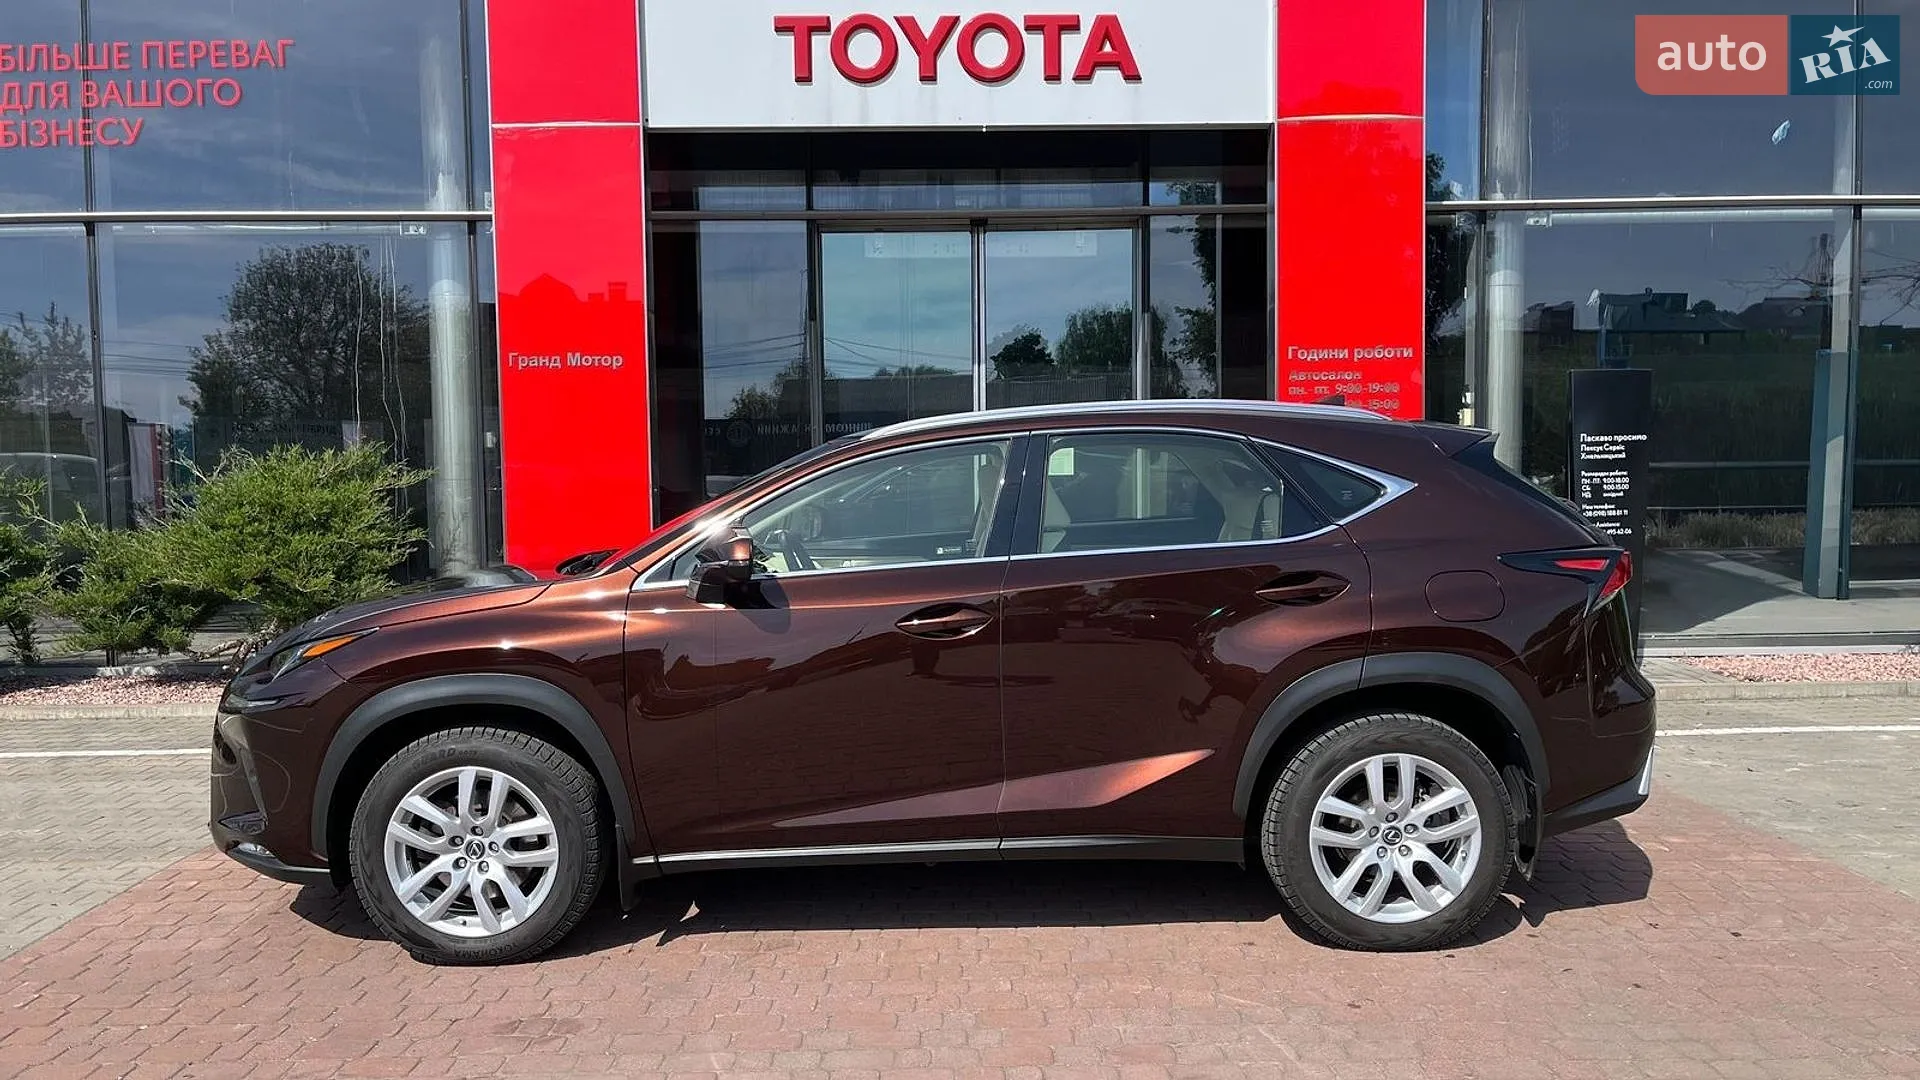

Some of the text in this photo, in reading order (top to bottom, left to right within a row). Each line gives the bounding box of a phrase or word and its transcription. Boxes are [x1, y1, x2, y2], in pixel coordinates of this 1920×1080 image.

[0, 39, 295, 72] БІЛЬШЕ ПЕРЕВАГ
[773, 13, 1142, 84] TOYOTA
[0, 78, 244, 115] ДЛЯ ВАШОГО
[0, 117, 145, 148] БІЗНЕСУ
[508, 352, 623, 370] Гранд Мотор
[1287, 344, 1414, 362] Години роботи
[1288, 370, 1362, 381] Автосалон
[1614, 434, 1648, 443] просимо
